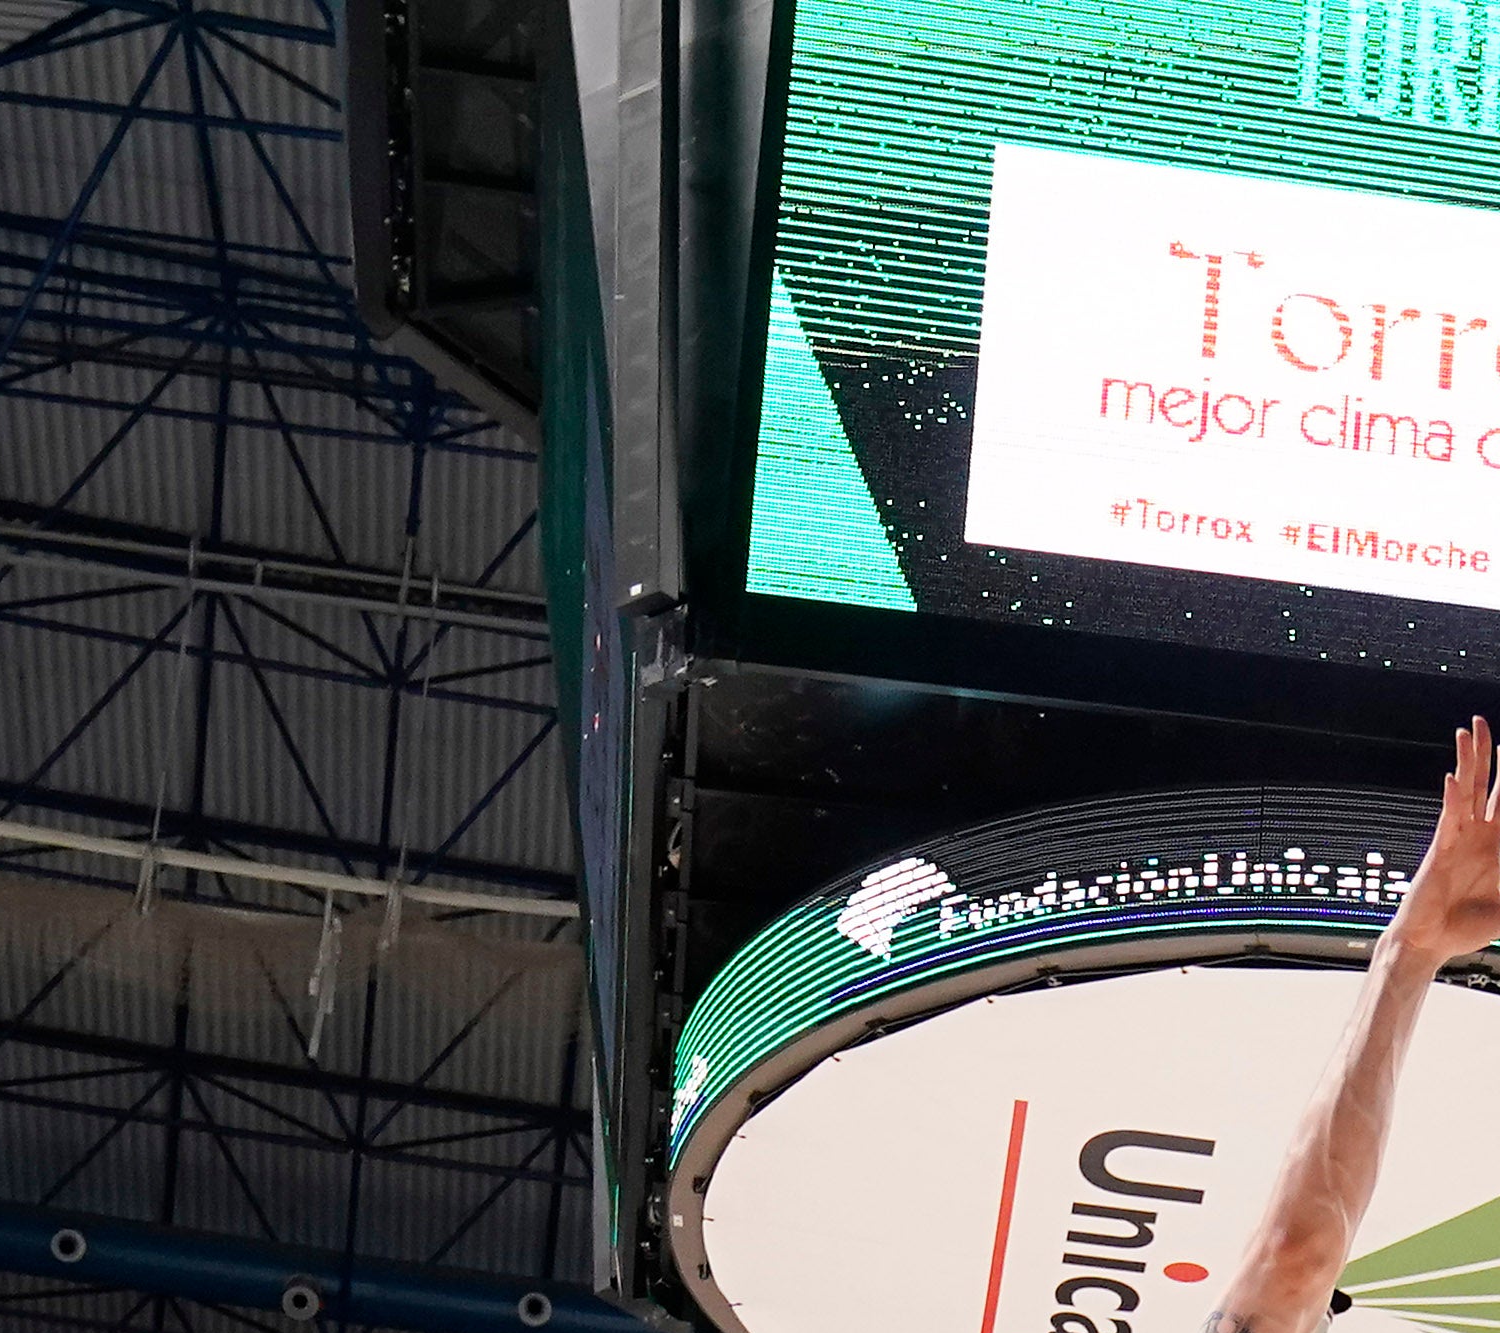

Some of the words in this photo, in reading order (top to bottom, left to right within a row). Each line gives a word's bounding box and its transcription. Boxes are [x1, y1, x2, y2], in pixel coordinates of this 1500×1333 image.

[1102, 376, 1280, 443] mejor
[1301, 394, 1457, 464] clima
[1111, 499, 1255, 545] #Torrox
